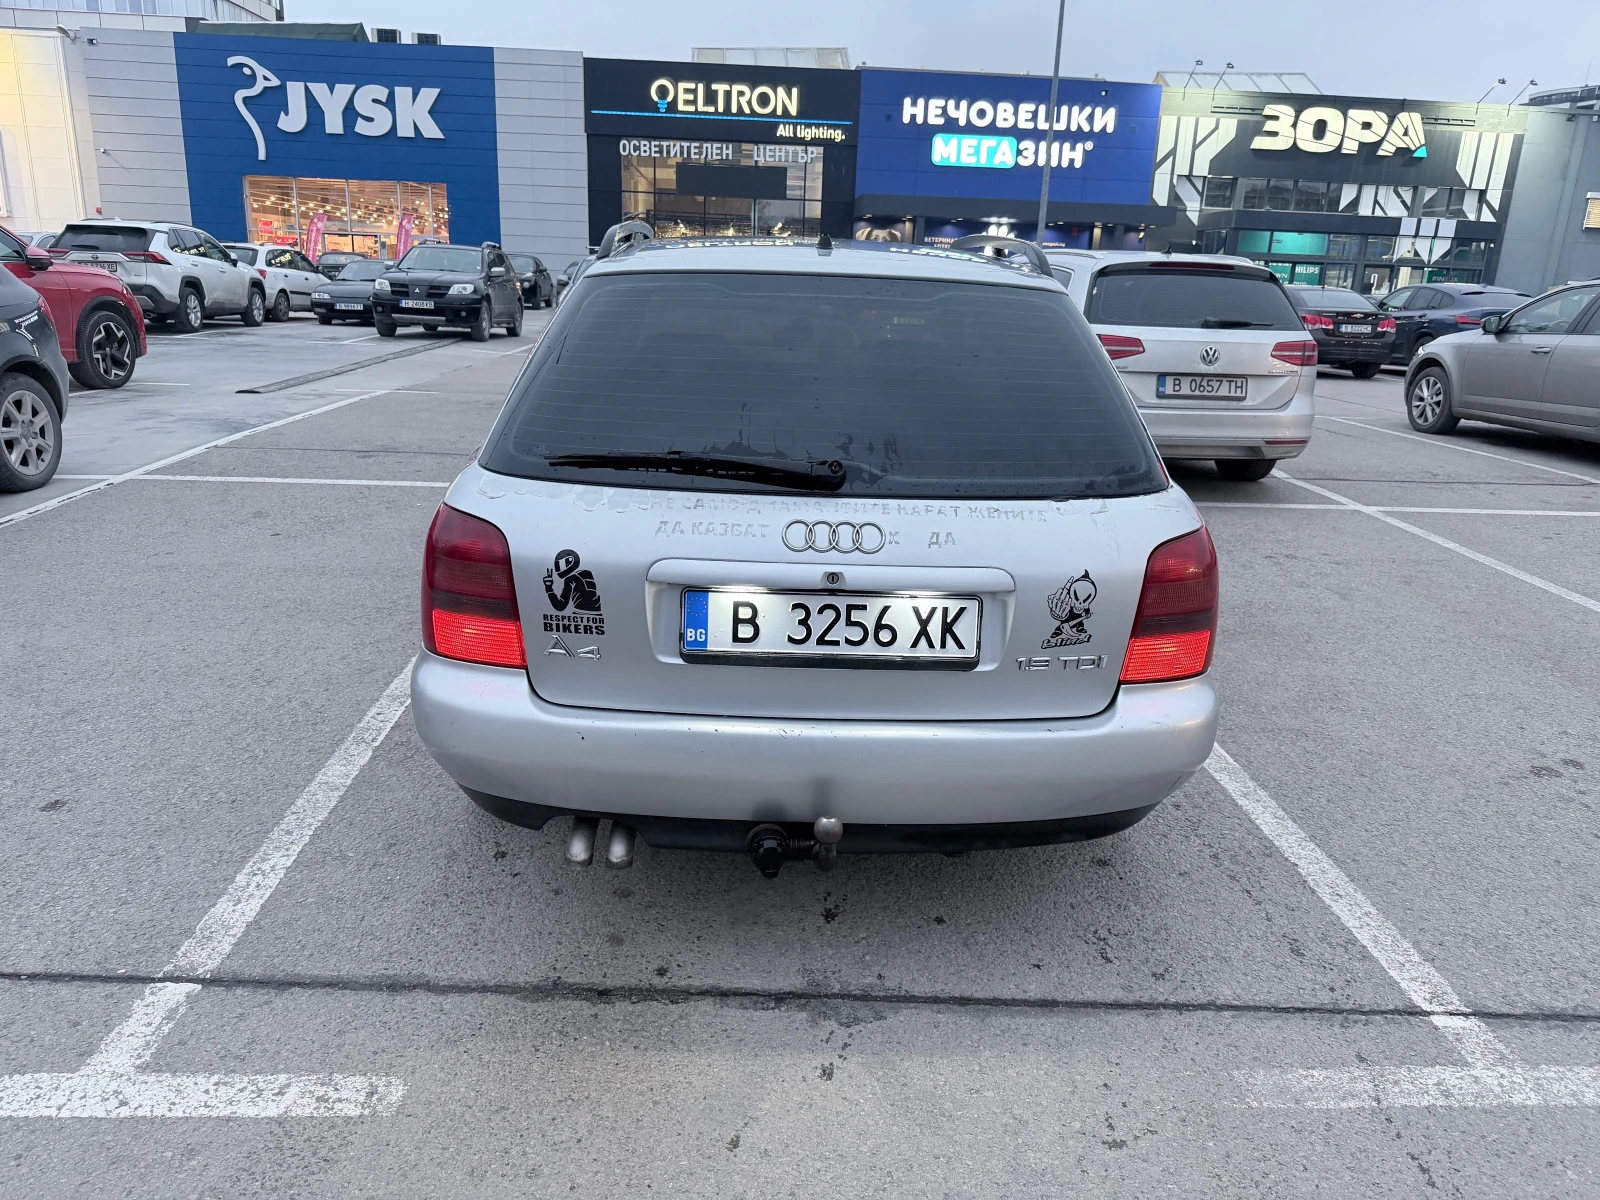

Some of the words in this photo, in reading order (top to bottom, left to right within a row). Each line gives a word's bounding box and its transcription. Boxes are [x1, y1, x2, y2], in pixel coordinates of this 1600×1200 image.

[277, 81, 445, 139] JYSK
[677, 82, 798, 116] ELTRON
[902, 97, 1116, 133] НЕЧОВЕШКИ
[776, 124, 794, 138] All
[797, 126, 846, 142] lighting.
[1250, 104, 1428, 157] ЗОРА
[619, 139, 733, 160] ОСВЕТИТЕЛЕН
[753, 145, 818, 163] ЦЕНТЪР
[1295, 266, 1320, 274] HILIPS
[1189, 378, 1223, 393] 0657
[543, 614, 584, 624] RESPECT
[586, 616, 605, 625] FOR
[543, 622, 606, 636] BIKERS
[686, 629, 706, 642] BG
[732, 601, 760, 643] B
[787, 602, 898, 647] 3256
[543, 634, 602, 660] A4
[1058, 653, 1109, 670] TDI
